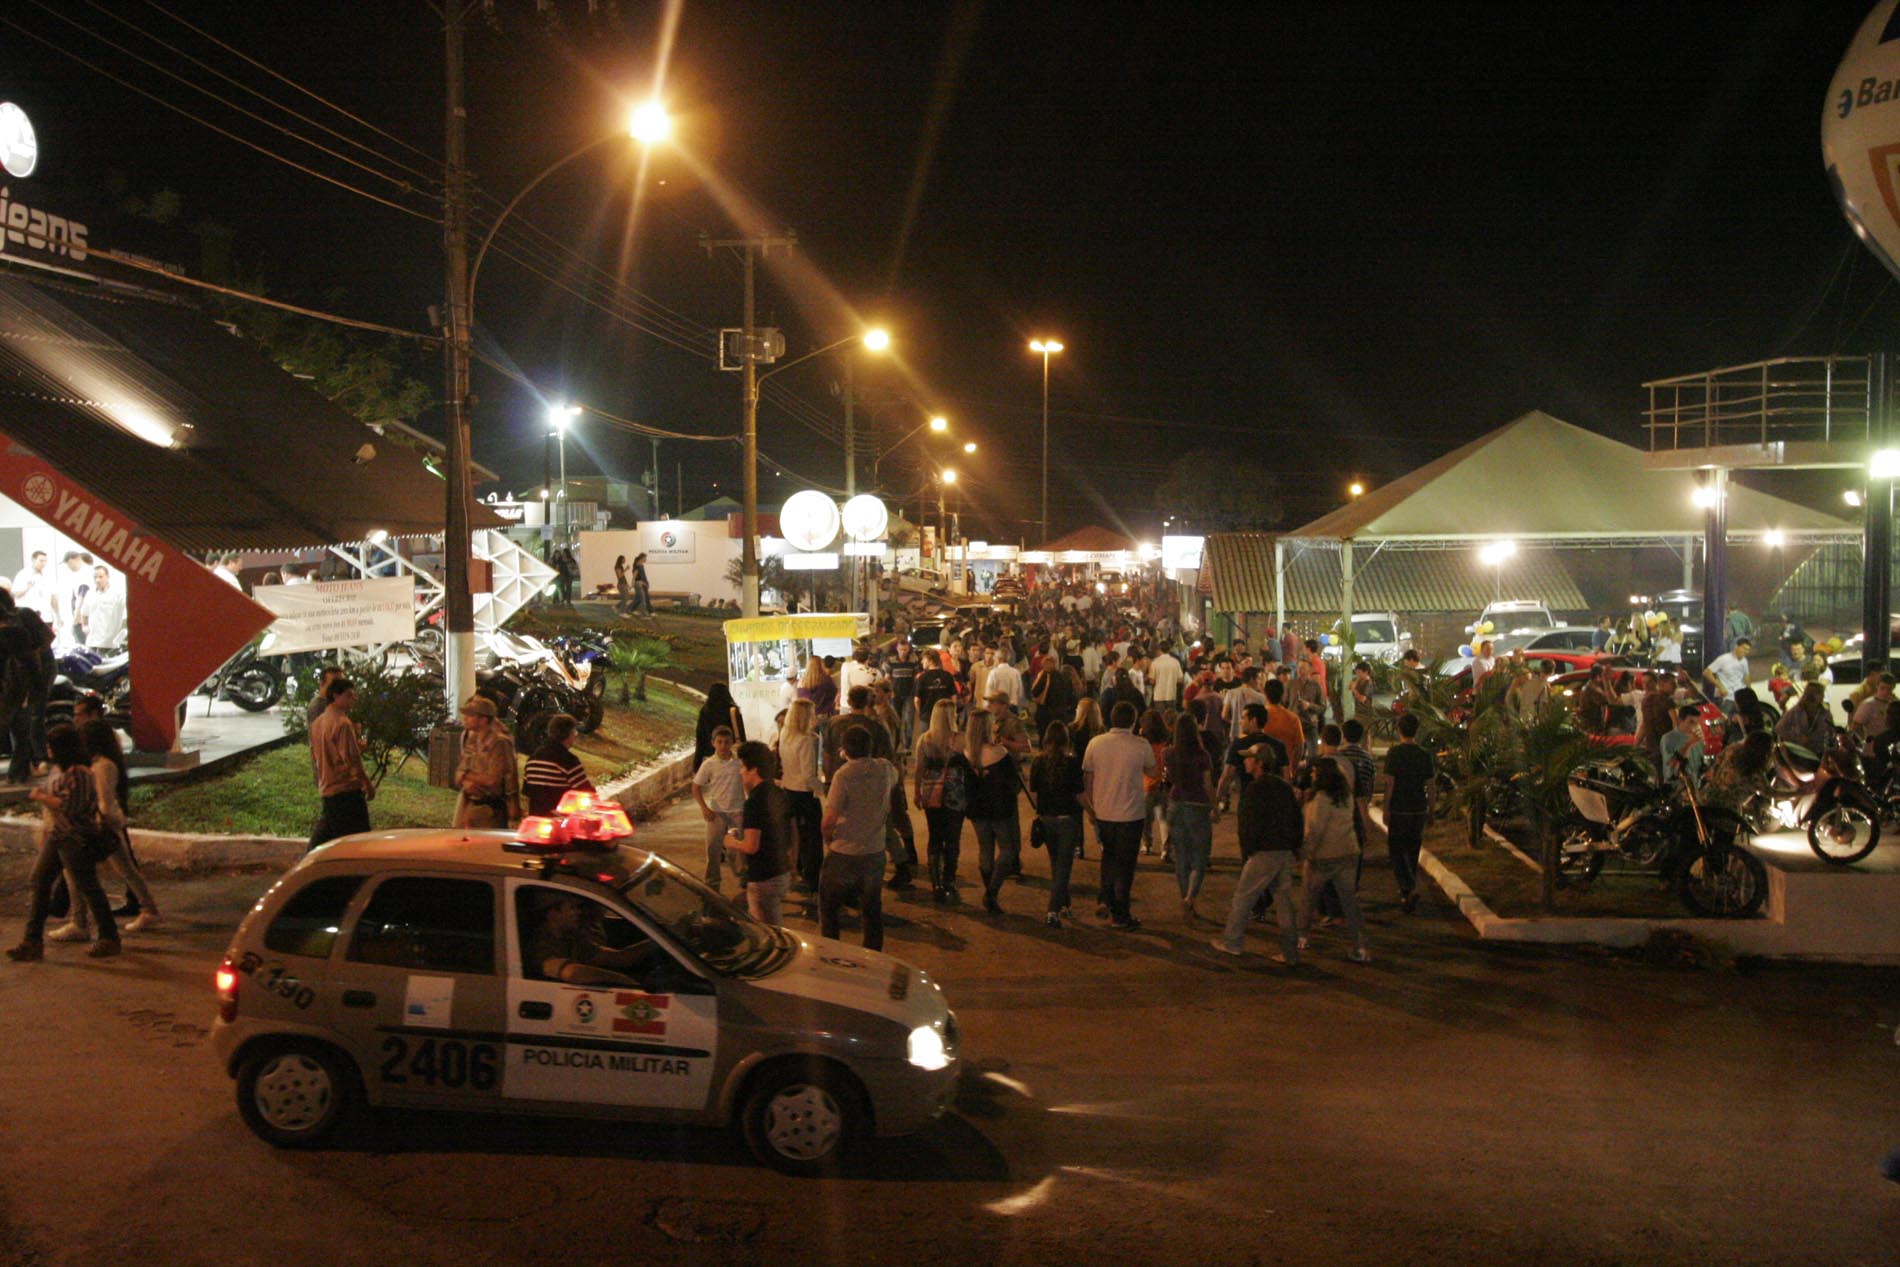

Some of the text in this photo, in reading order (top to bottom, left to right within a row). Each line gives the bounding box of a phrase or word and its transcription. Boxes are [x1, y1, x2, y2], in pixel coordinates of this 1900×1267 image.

[53, 489, 164, 583] YAMAHA
[381, 1035, 498, 1090] 2406
[609, 1055, 690, 1075] MILITAR
